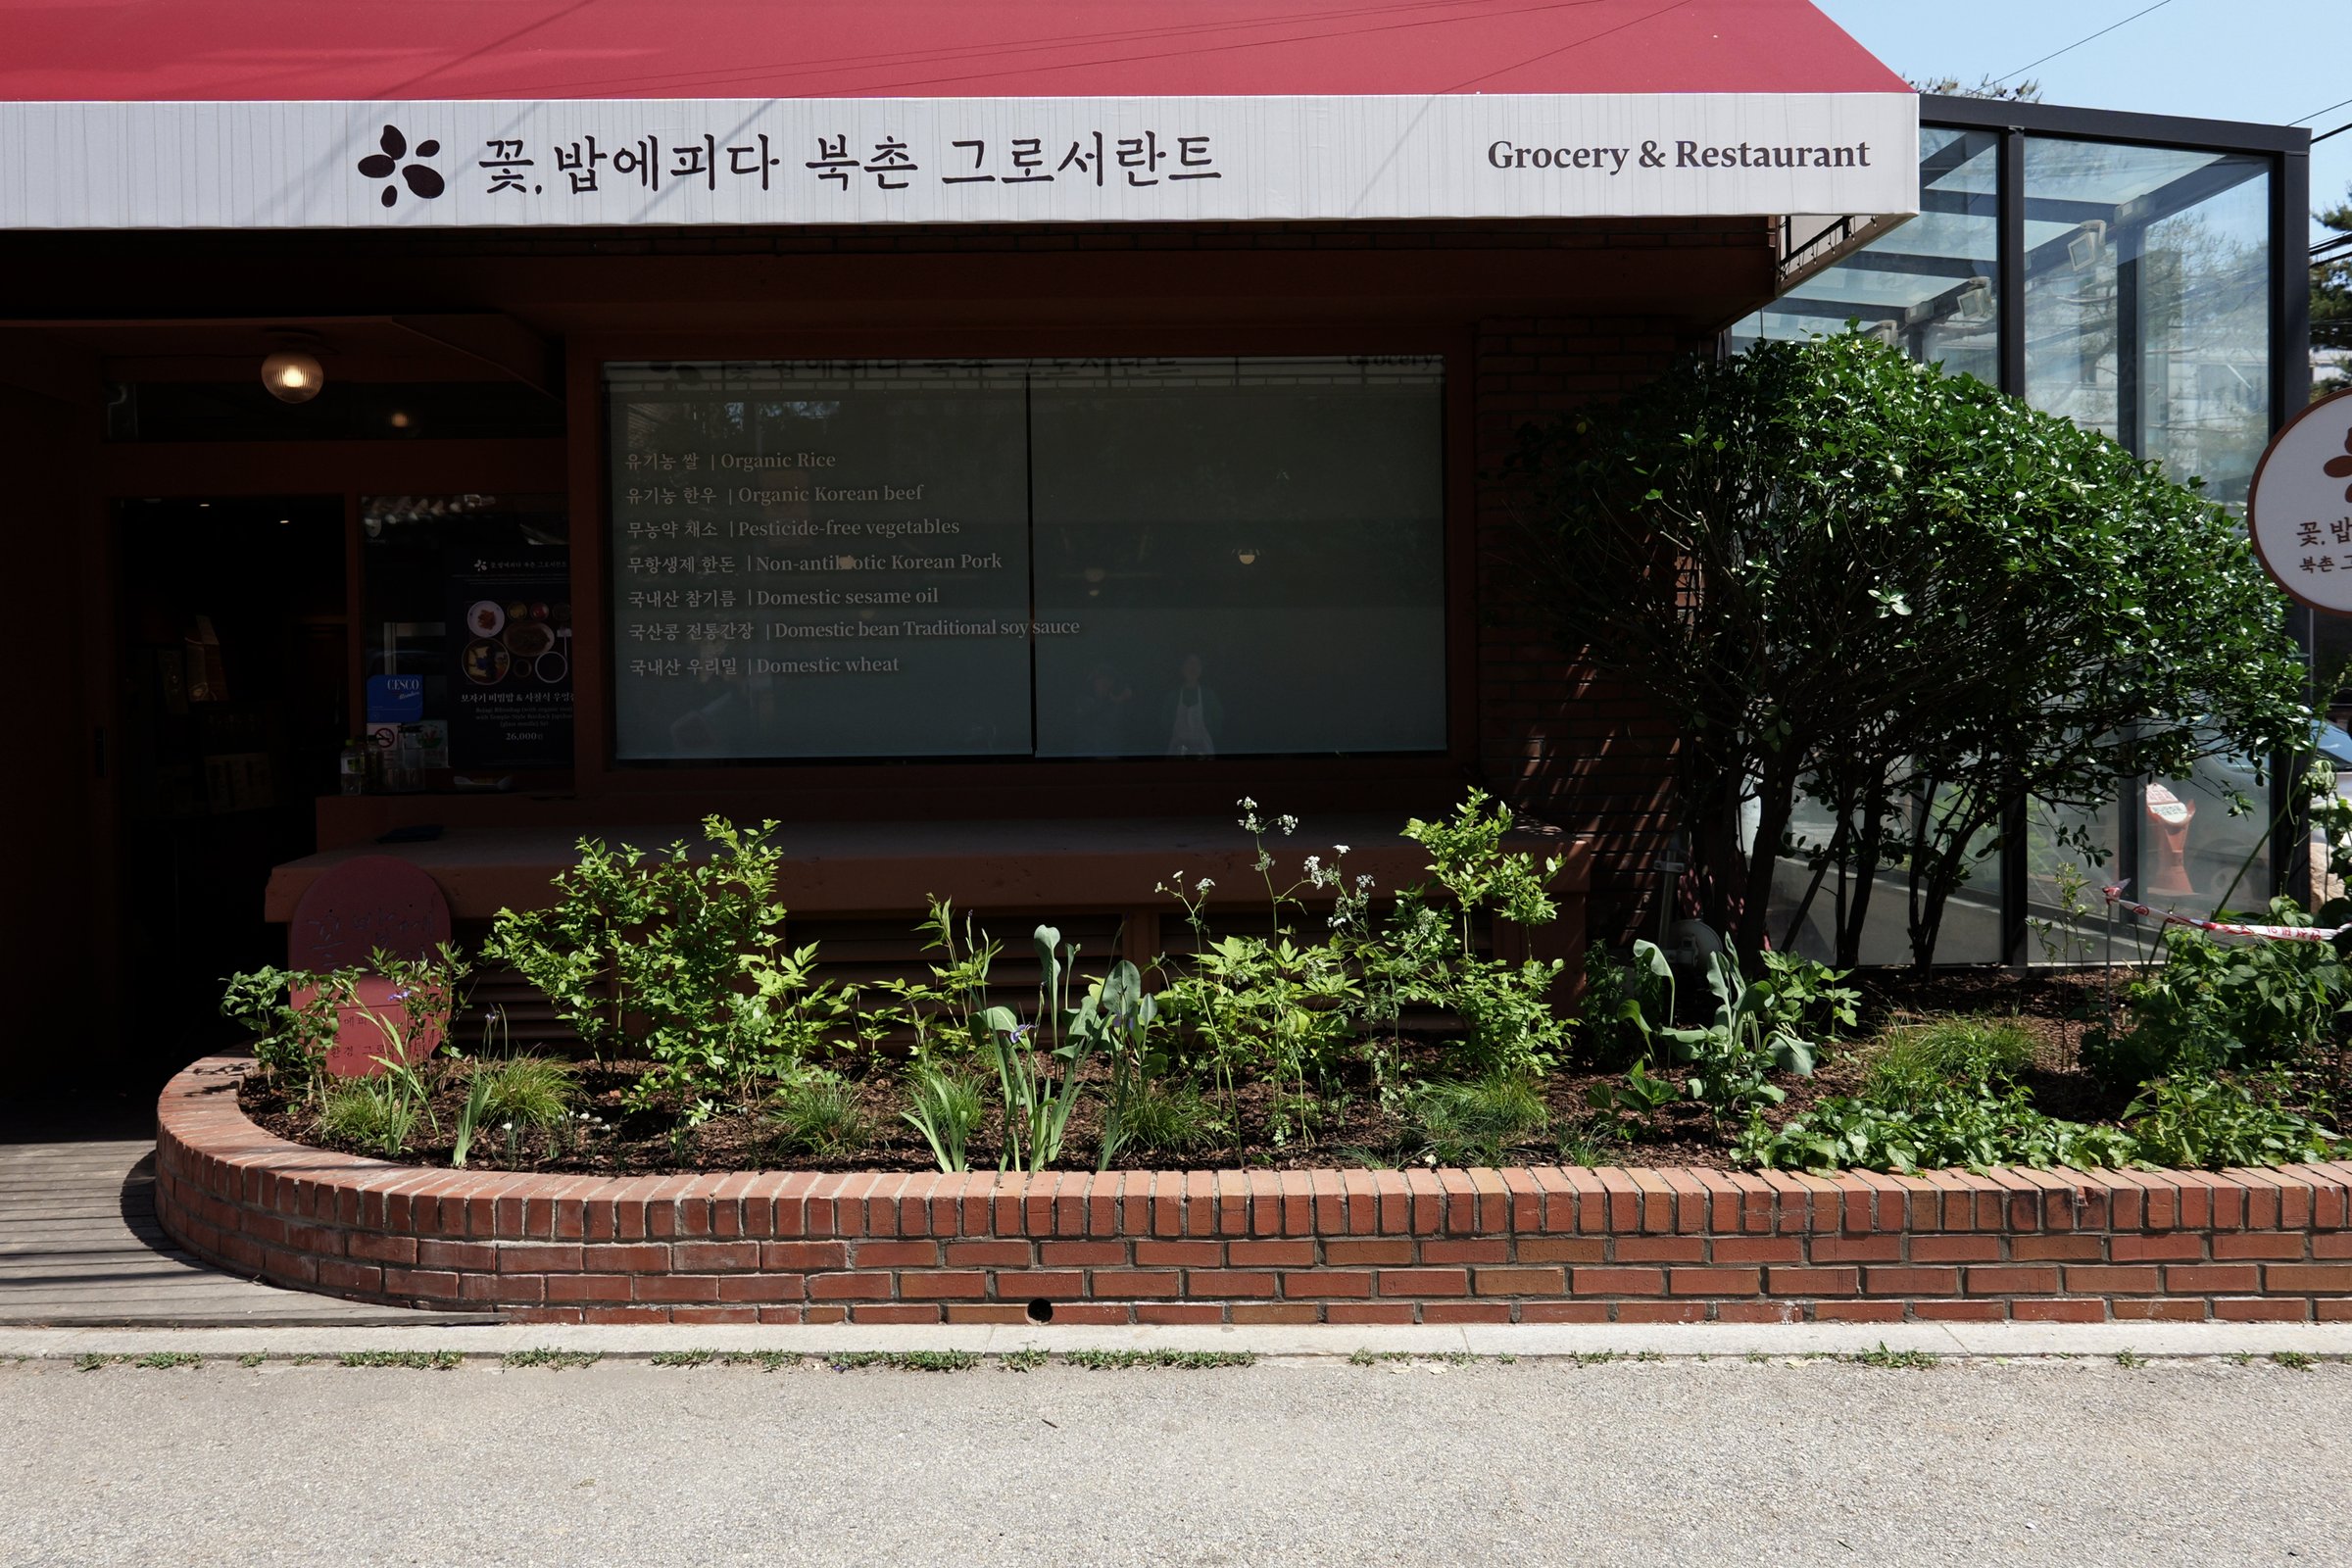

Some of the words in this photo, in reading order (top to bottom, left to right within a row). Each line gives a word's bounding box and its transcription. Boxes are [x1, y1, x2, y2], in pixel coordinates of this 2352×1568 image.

[805, 133, 919, 191] 북촌
[942, 129, 1222, 187] 그로서란트
[1487, 139, 1631, 176] Grocery
[1639, 139, 1667, 169] &
[1675, 139, 1872, 169] Restaurant
[625, 453, 677, 471] 유기농
[681, 451, 700, 471] 쌀
[720, 452, 792, 472] Organic
[797, 451, 836, 468] Rice
[626, 487, 677, 506] 유기농
[683, 486, 717, 505] 한우
[738, 486, 809, 507] Organic
[814, 486, 879, 502] Korean
[883, 484, 924, 501] beef
[627, 520, 679, 540] 무농약
[684, 520, 718, 538] 채소
[738, 519, 861, 537] Pesticide-free
[865, 518, 960, 539] vegetables
[627, 556, 695, 574] 무항생제
[702, 556, 735, 574] 한돈
[891, 554, 956, 570] Korean
[960, 553, 1003, 569] Pork
[2299, 555, 2335, 574] 북촌
[628, 590, 679, 609] 국내산
[685, 589, 737, 608] 참기름
[757, 588, 841, 606] Domestic
[846, 590, 911, 605] sesame
[915, 587, 939, 604] oil
[628, 622, 680, 641] 국산콩
[686, 621, 755, 641] 전통간장
[774, 621, 855, 638] Domestic
[858, 620, 901, 637] bean
[903, 619, 997, 636] Traditional
[1001, 622, 1029, 639] soy
[1032, 620, 1080, 635] sauce
[629, 658, 681, 676] 국내산
[687, 657, 738, 676] 우리밀
[757, 657, 841, 674] Domestic
[846, 657, 900, 674] wheat
[387, 678, 420, 690] CESCO
